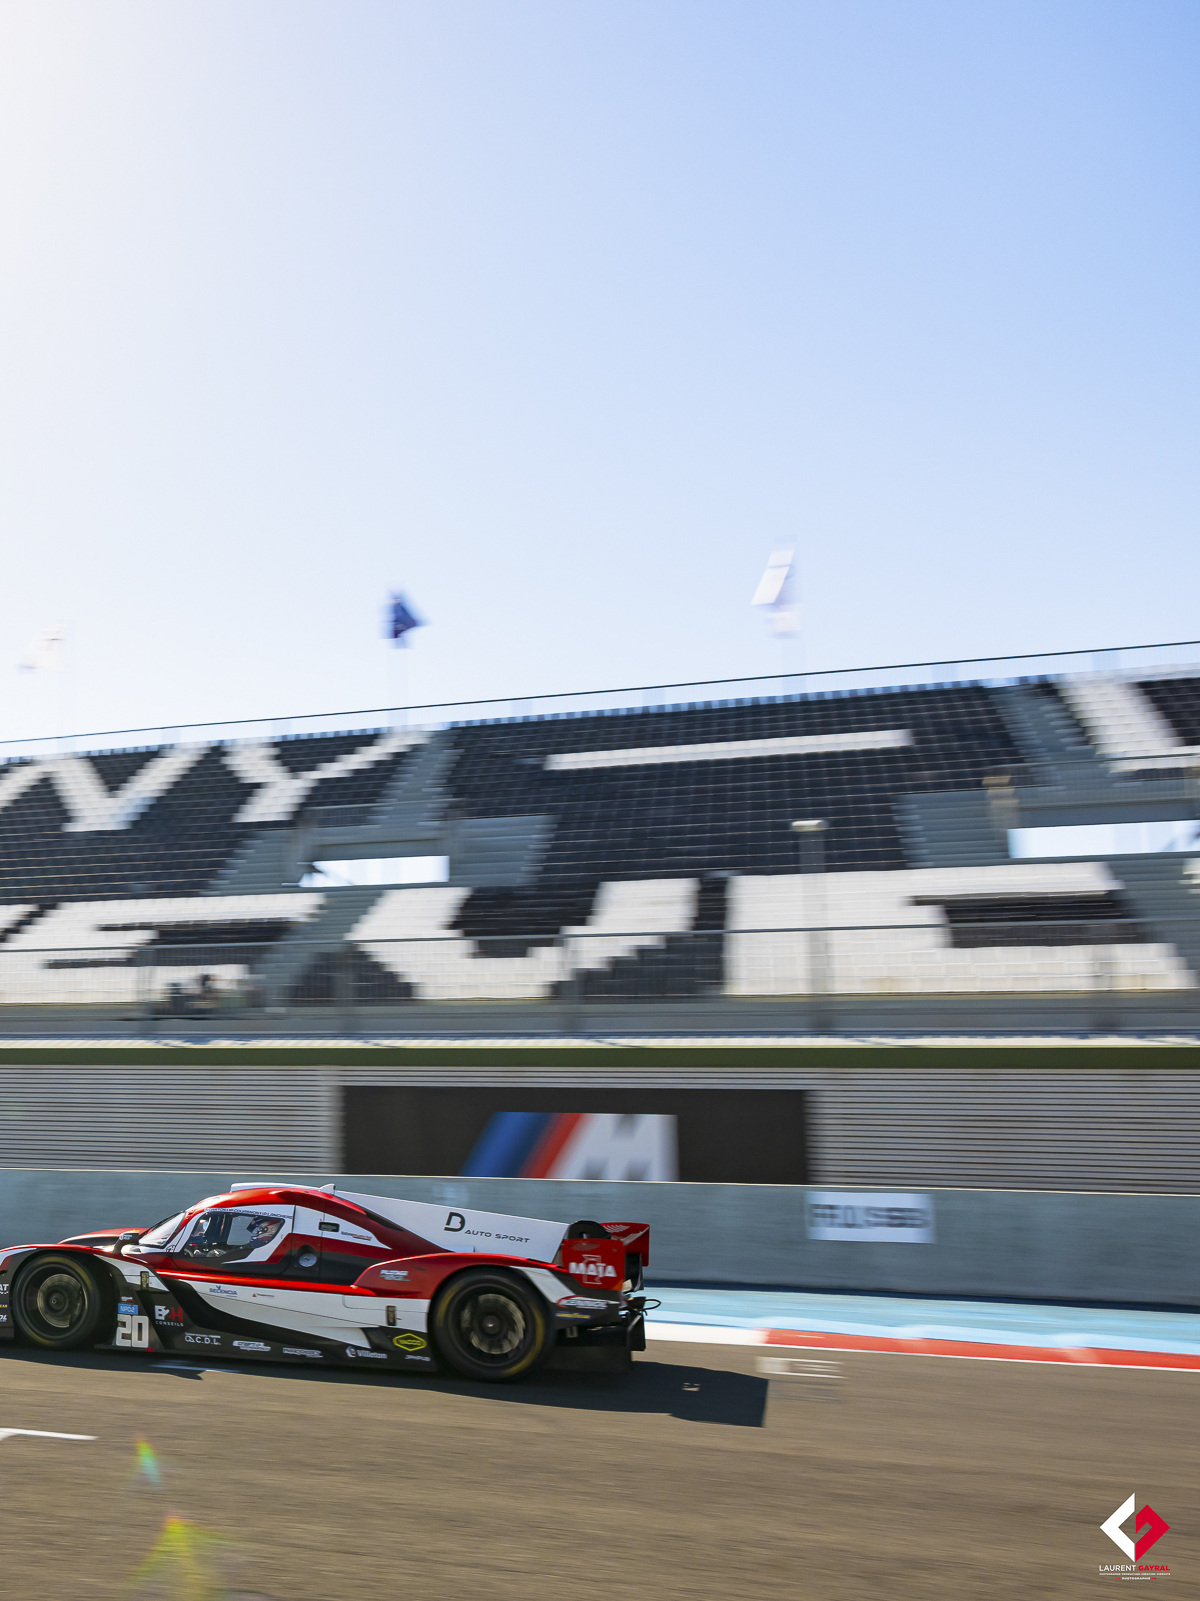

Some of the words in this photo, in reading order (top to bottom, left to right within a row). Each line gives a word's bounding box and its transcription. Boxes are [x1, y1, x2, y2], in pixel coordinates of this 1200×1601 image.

[464, 1229, 492, 1238] AUTO
[494, 1233, 530, 1244] SPORT
[116, 1314, 149, 1348] 20
